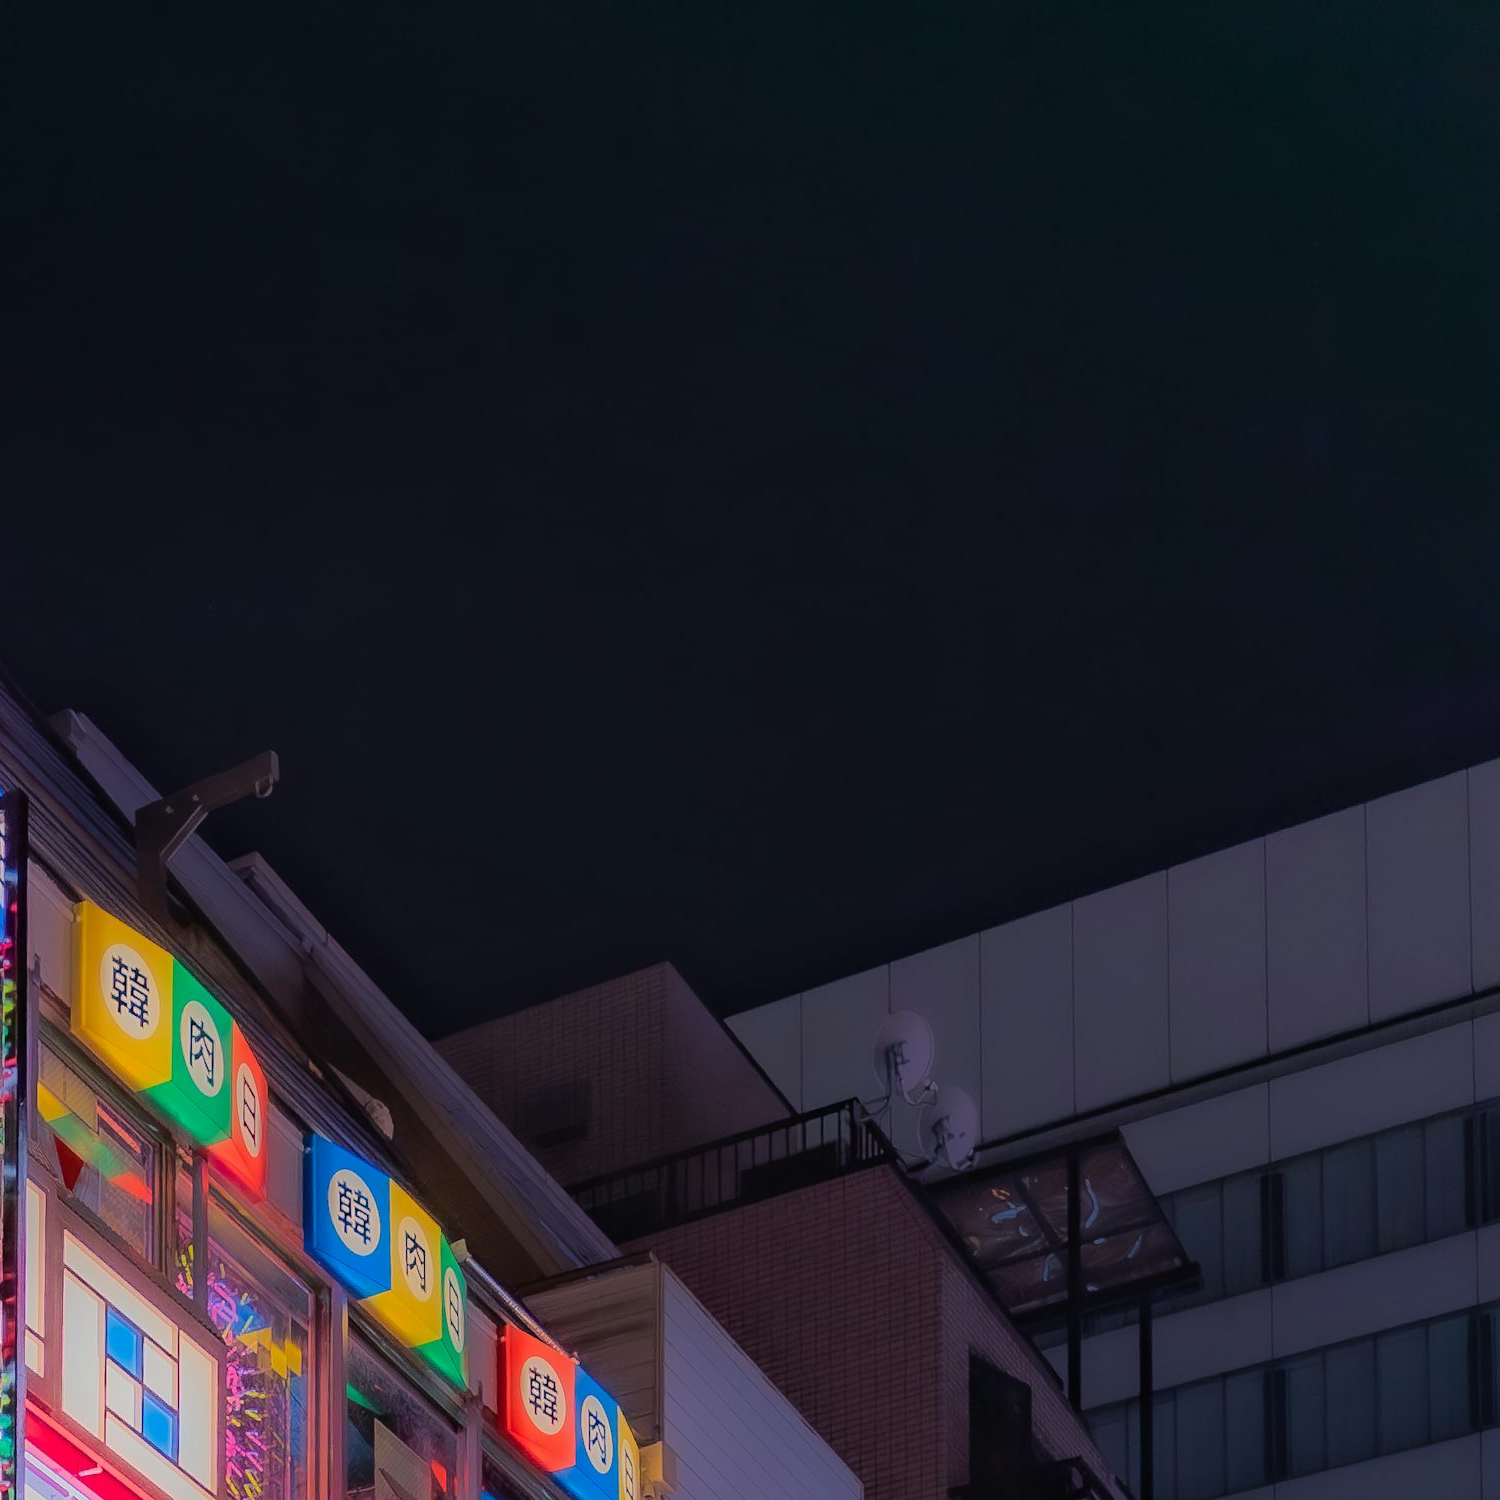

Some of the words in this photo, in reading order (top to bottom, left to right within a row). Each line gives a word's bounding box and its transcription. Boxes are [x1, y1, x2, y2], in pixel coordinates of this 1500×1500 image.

[111, 953, 151, 1030] 韓
[189, 1017, 217, 1086] 肉
[339, 1179, 374, 1246] 韓
[404, 1229, 428, 1293] 肉
[527, 1365, 558, 1429] 韓
[586, 1407, 610, 1463] 肉
